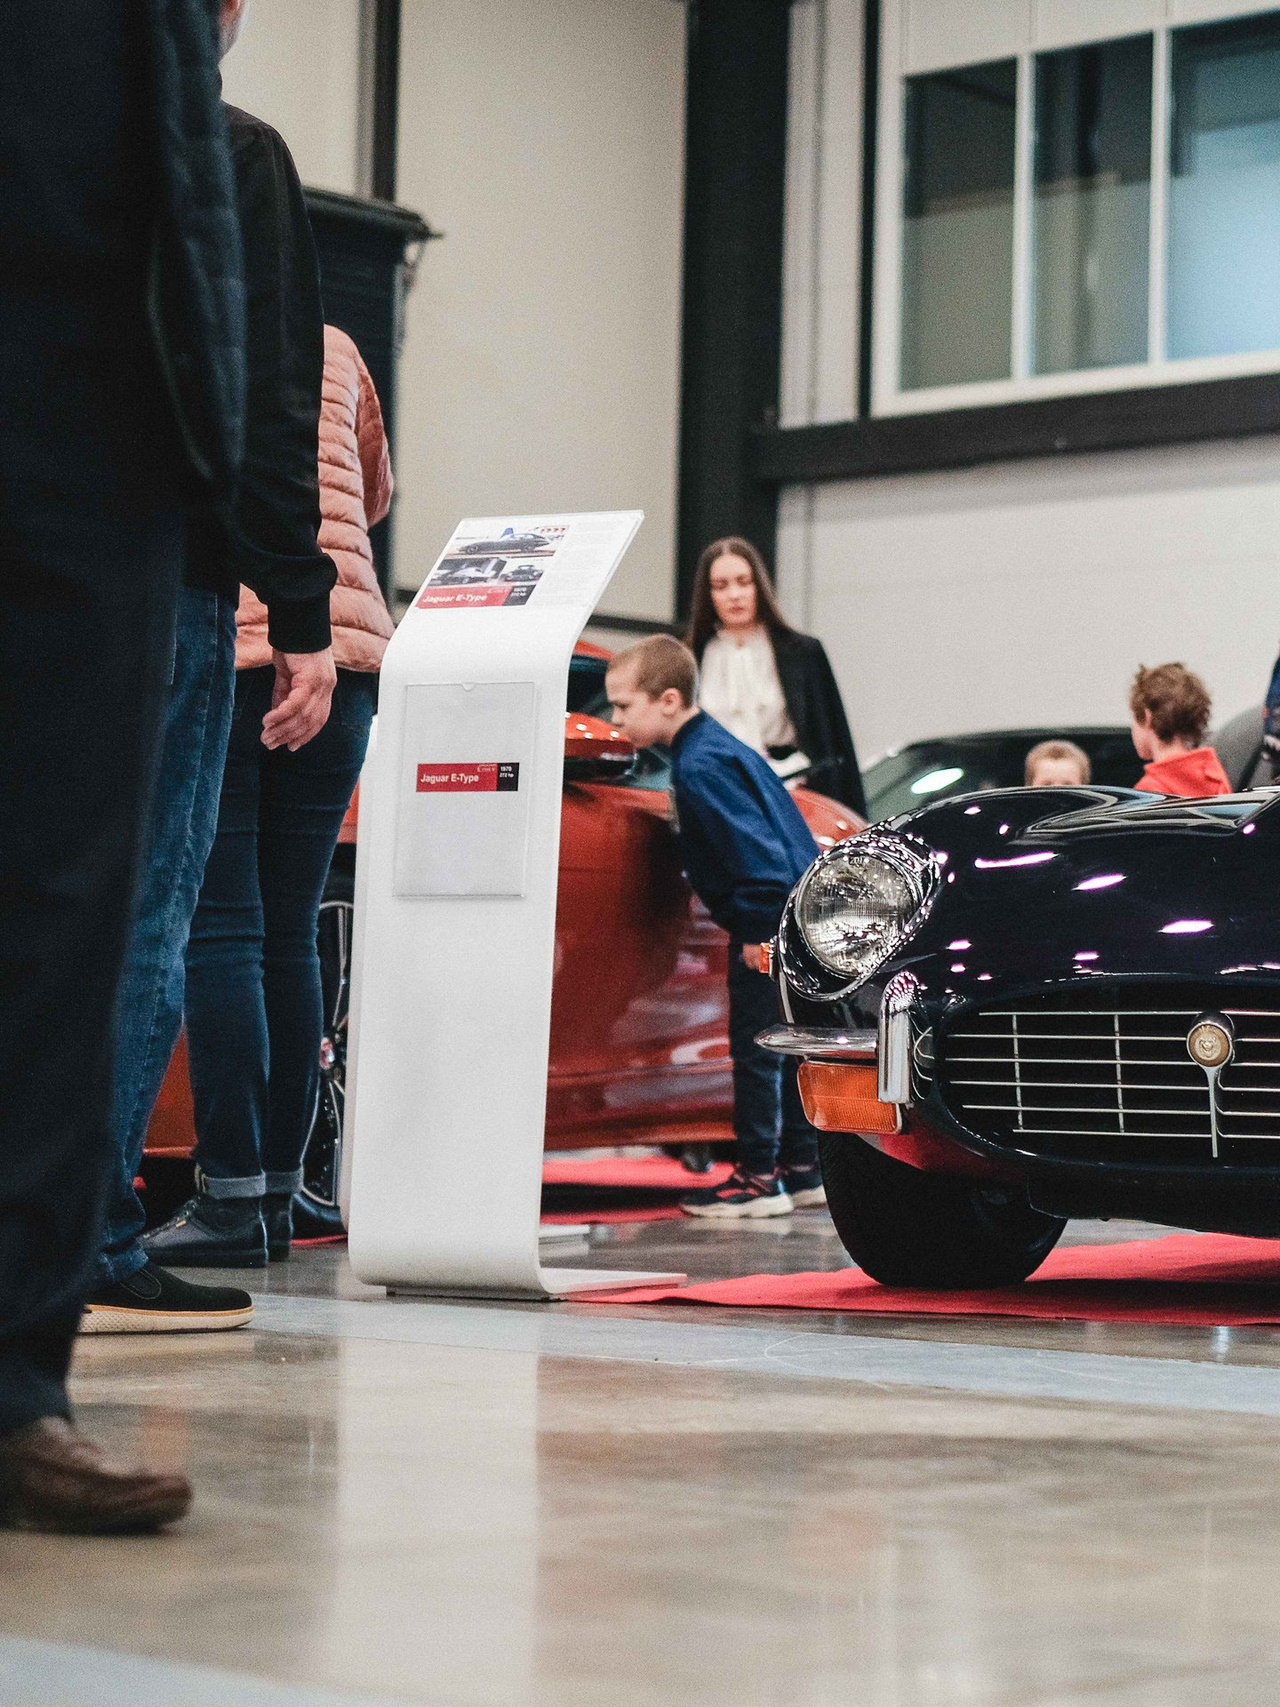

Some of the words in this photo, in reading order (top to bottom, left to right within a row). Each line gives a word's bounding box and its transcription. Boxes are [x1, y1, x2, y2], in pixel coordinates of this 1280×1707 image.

[422, 595, 453, 603] Jaguar
[455, 594, 487, 602] E-Type
[420, 773, 449, 785] Jaguar
[450, 773, 480, 784] E-Type
